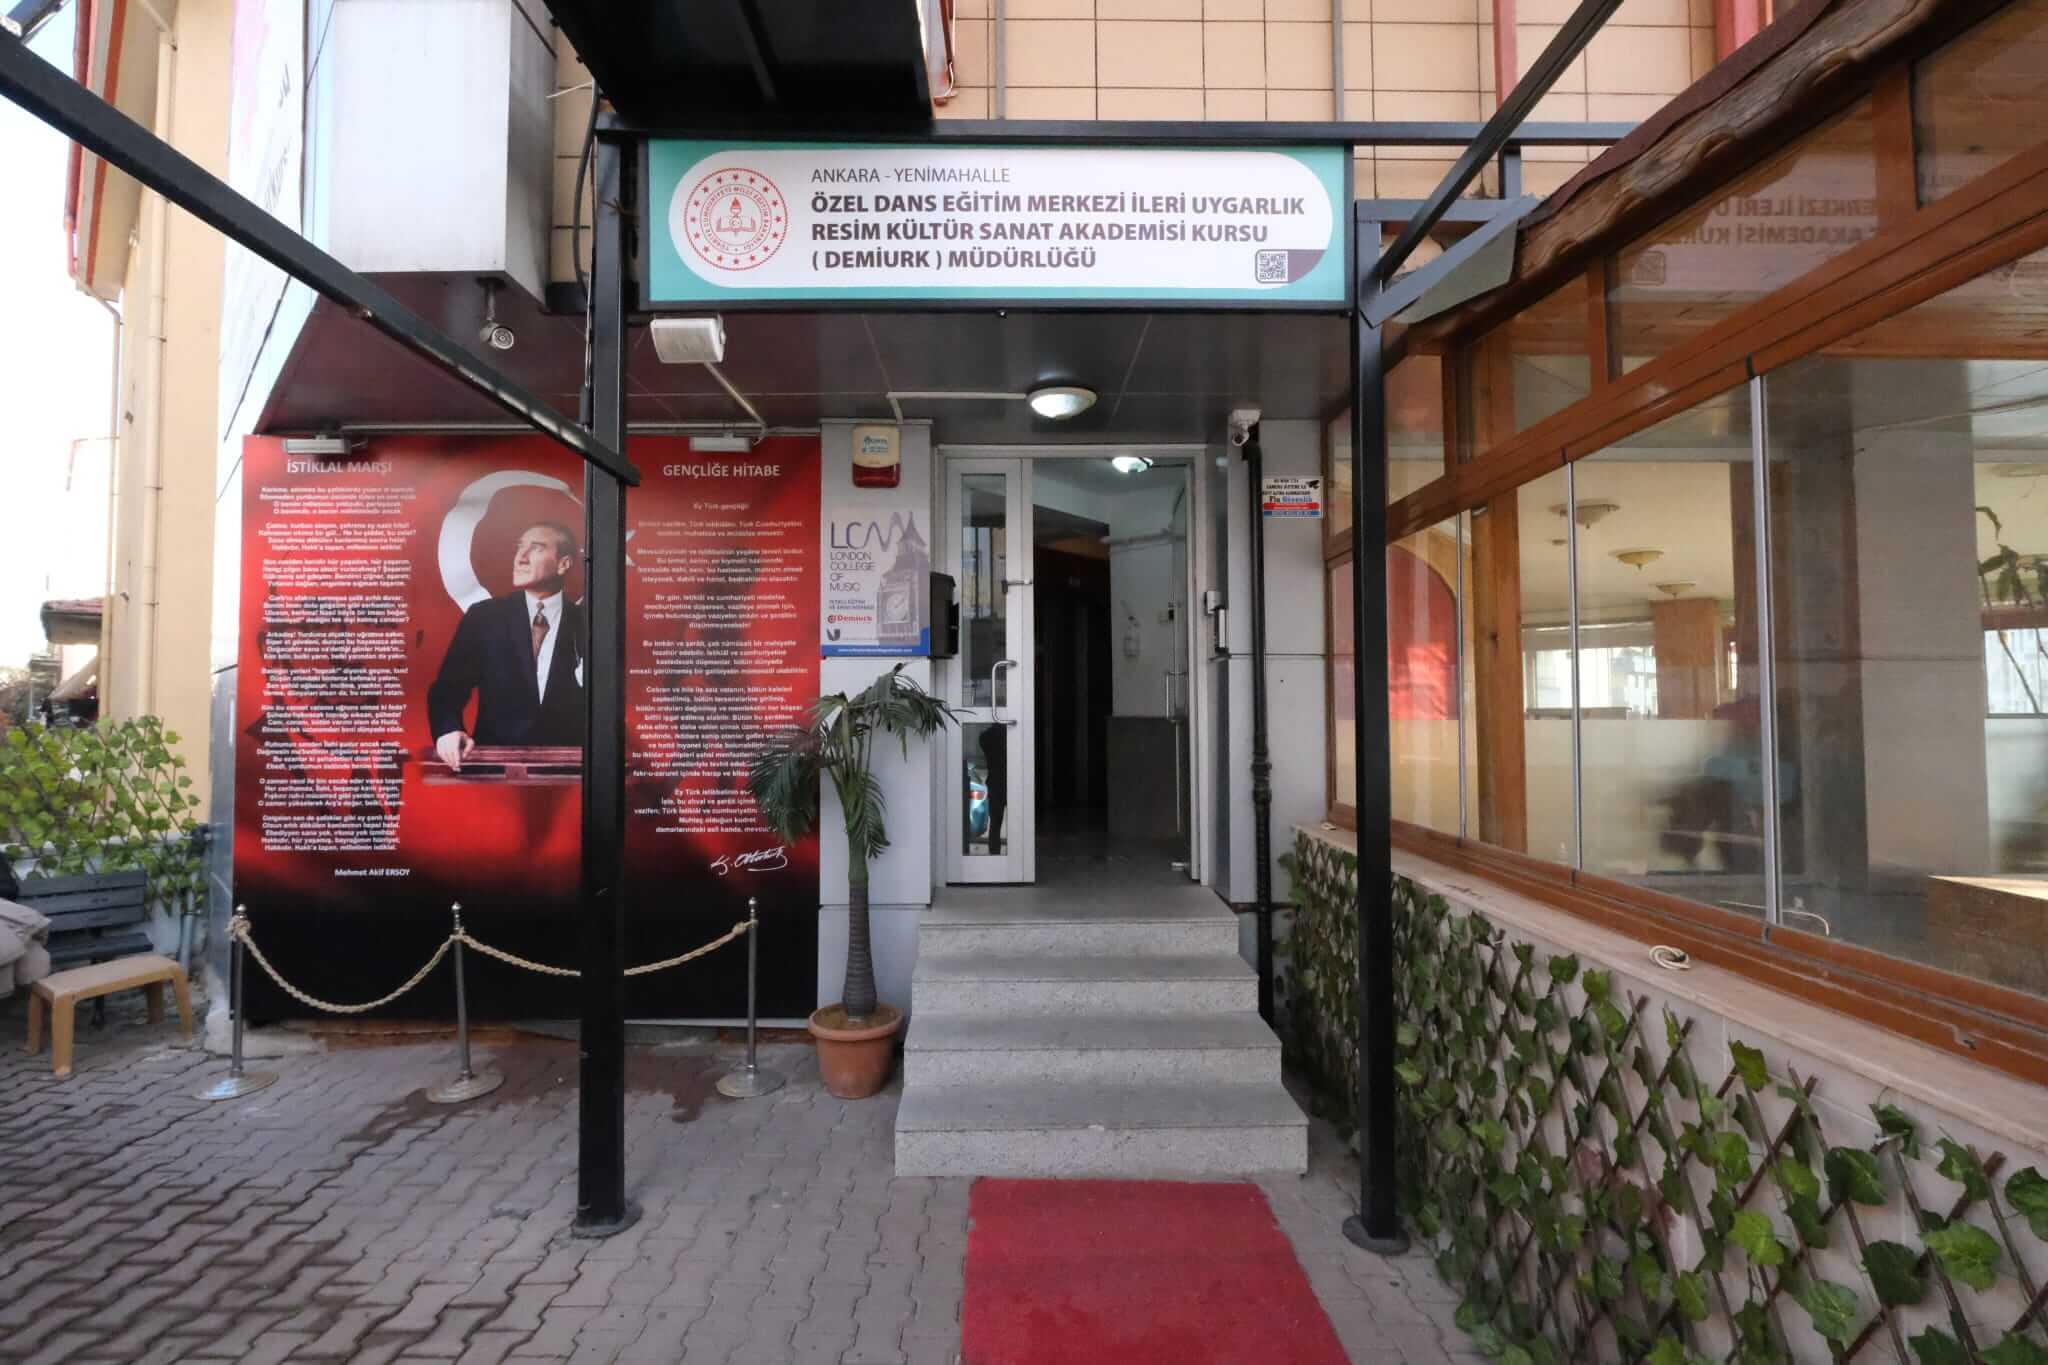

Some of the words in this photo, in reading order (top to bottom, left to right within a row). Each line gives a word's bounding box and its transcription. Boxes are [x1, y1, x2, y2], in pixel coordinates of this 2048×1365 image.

[811, 168, 880, 183] ANKARA
[894, 165, 1010, 183] YENİMAHALLE
[811, 191, 868, 213] ÖZEL
[875, 195, 937, 213] DANS
[943, 191, 1021, 213] EĞİTİM
[1027, 192, 1125, 213] MERKEZİ
[1131, 192, 1186, 213] İLERİ
[1192, 197, 1305, 215] UYGARLIK
[812, 219, 880, 240] RESİM
[887, 218, 974, 240] KÜLTÜR
[979, 222, 1053, 240] SANAT
[1059, 220, 1186, 241] AKADEMİSİ
[1191, 224, 1269, 242] KURSU
[948, 247, 1096, 268] MÜDÜRLÜĞÜ
[287, 460, 344, 473] İSTİKLAL
[347, 461, 392, 476] MARŞI
[663, 462, 729, 479] GENÇLİĞE
[733, 462, 781, 477] HİTABE
[830, 551, 872, 561] LONDON
[830, 562, 876, 571] COLLEGE
[830, 573, 844, 582] OF
[830, 583, 861, 592] MUSIC
